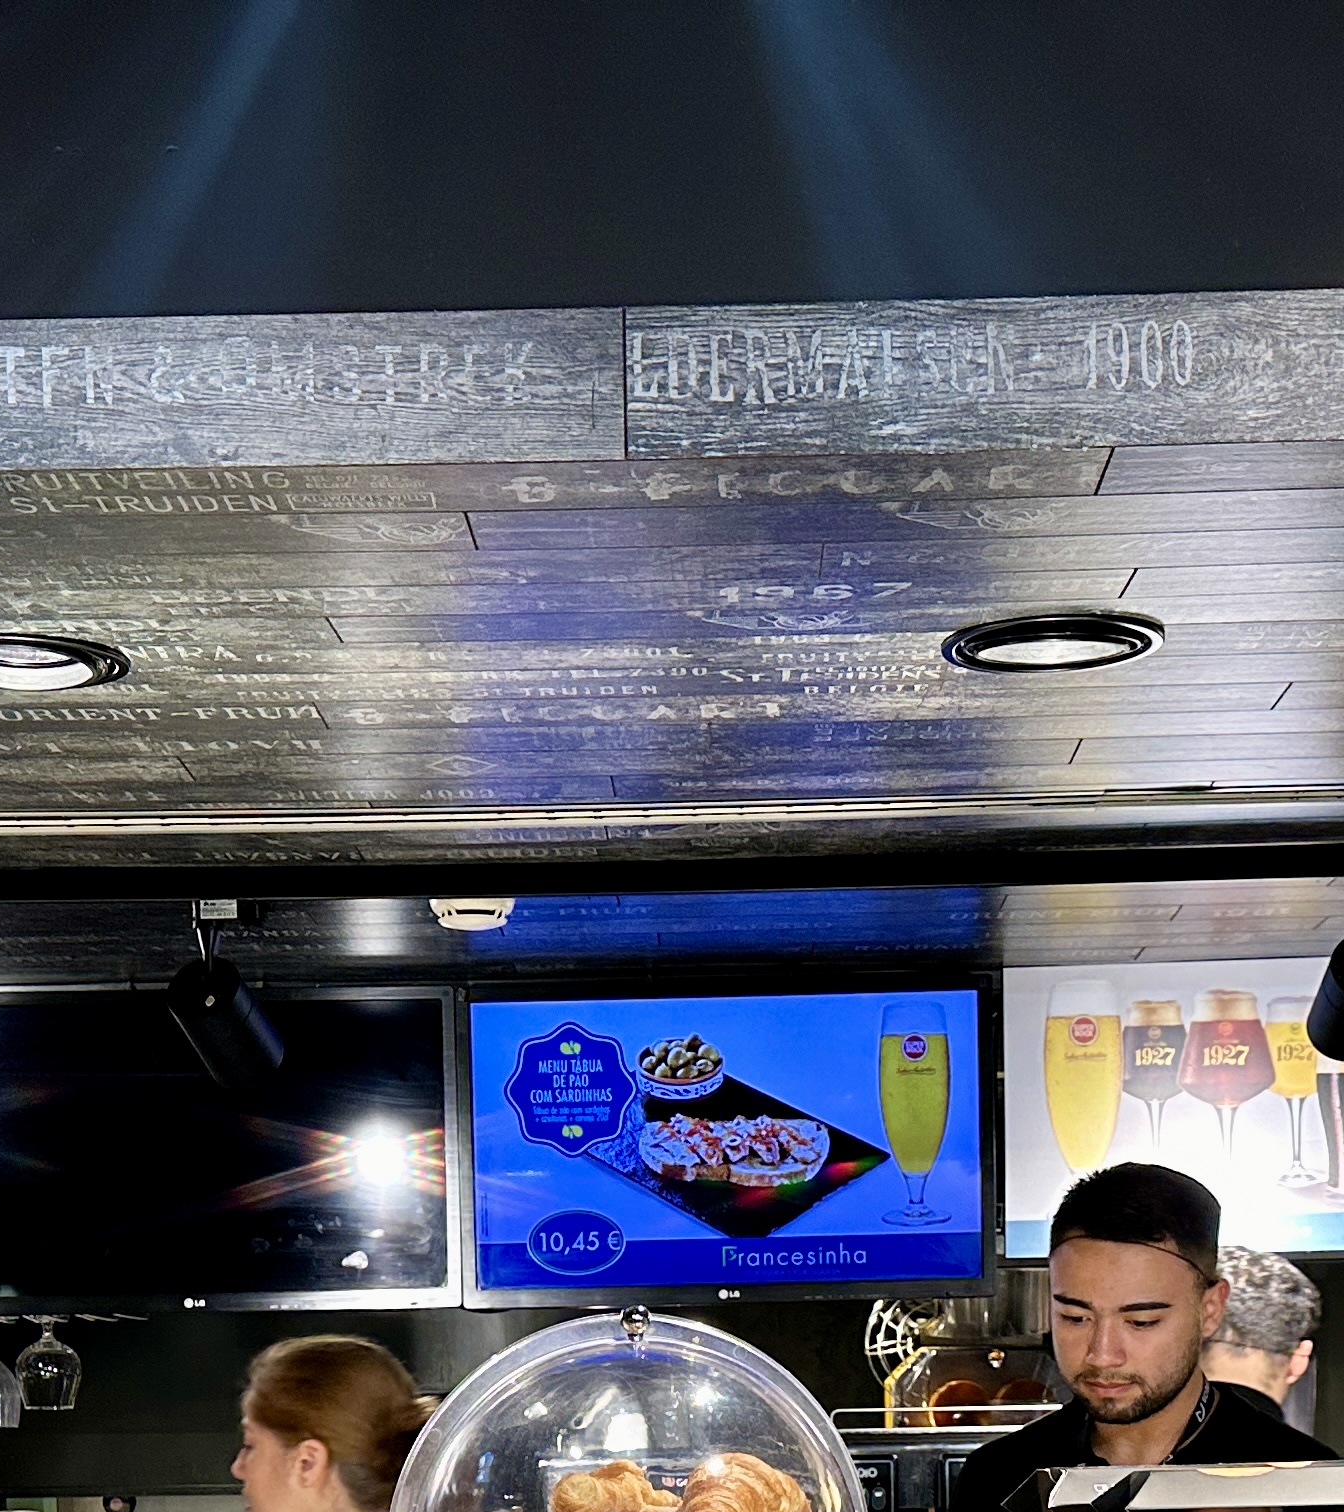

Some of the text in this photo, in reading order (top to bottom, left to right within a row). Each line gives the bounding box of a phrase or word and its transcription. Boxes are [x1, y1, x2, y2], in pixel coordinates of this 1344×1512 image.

[1134, 1047, 1176, 1067] 1927
[1202, 1043, 1250, 1067] 1927
[1276, 1043, 1314, 1062] 1927
[538, 1059, 568, 1074] MENU
[552, 1074, 567, 1088] DE
[530, 1087, 613, 1104] COM SARDINHAS
[538, 1229, 622, 1254] 10,45 €
[720, 1242, 868, 1268] Francesinha
